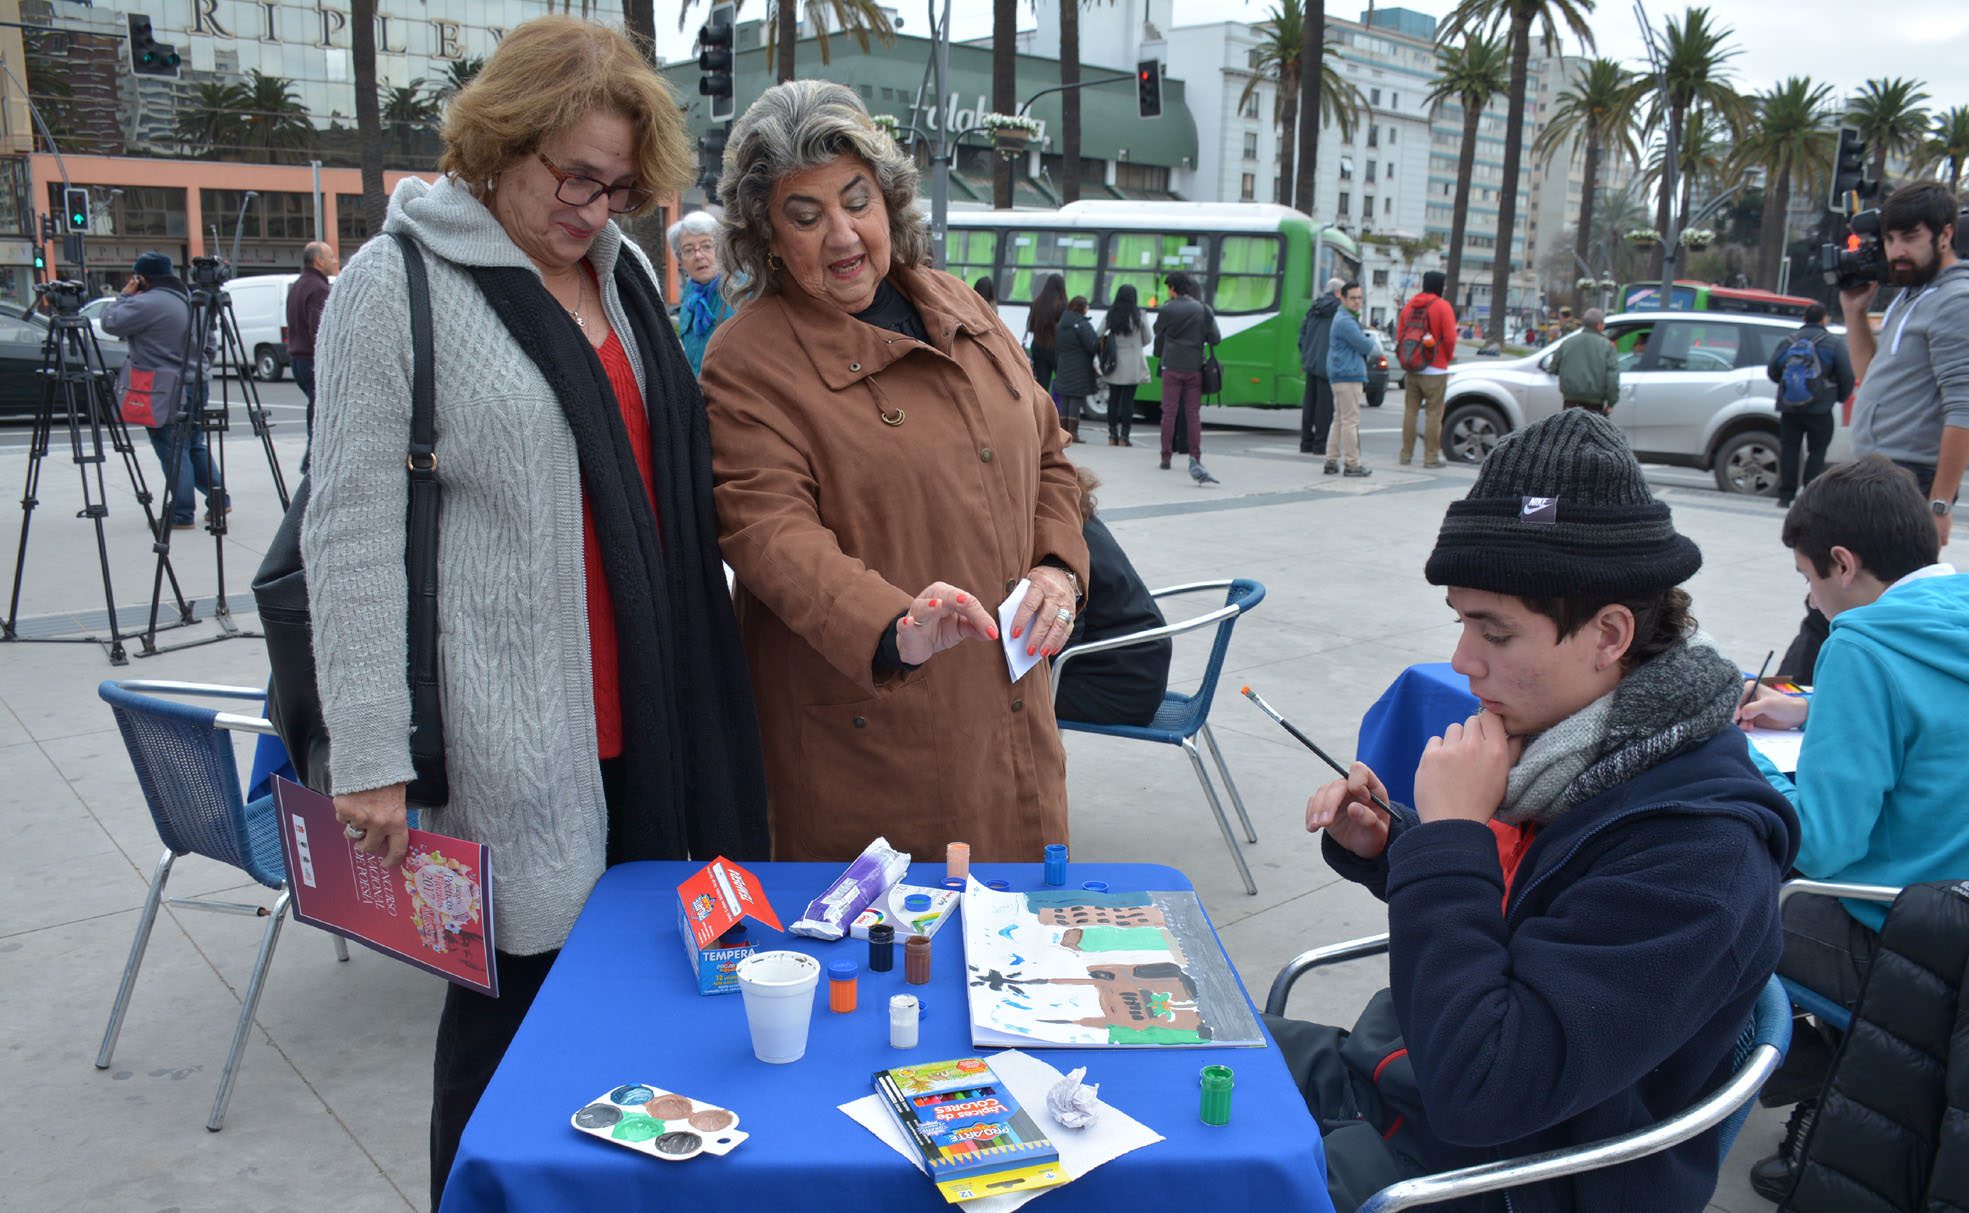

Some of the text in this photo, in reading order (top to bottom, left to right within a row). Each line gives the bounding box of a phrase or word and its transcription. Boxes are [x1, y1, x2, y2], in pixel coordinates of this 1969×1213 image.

[903, 84, 1048, 143] falaba
[1529, 497, 1549, 506] NIKE
[703, 948, 755, 962] TEMPERA
[934, 1098, 999, 1114] COLORES
[936, 1113, 954, 1121] de
